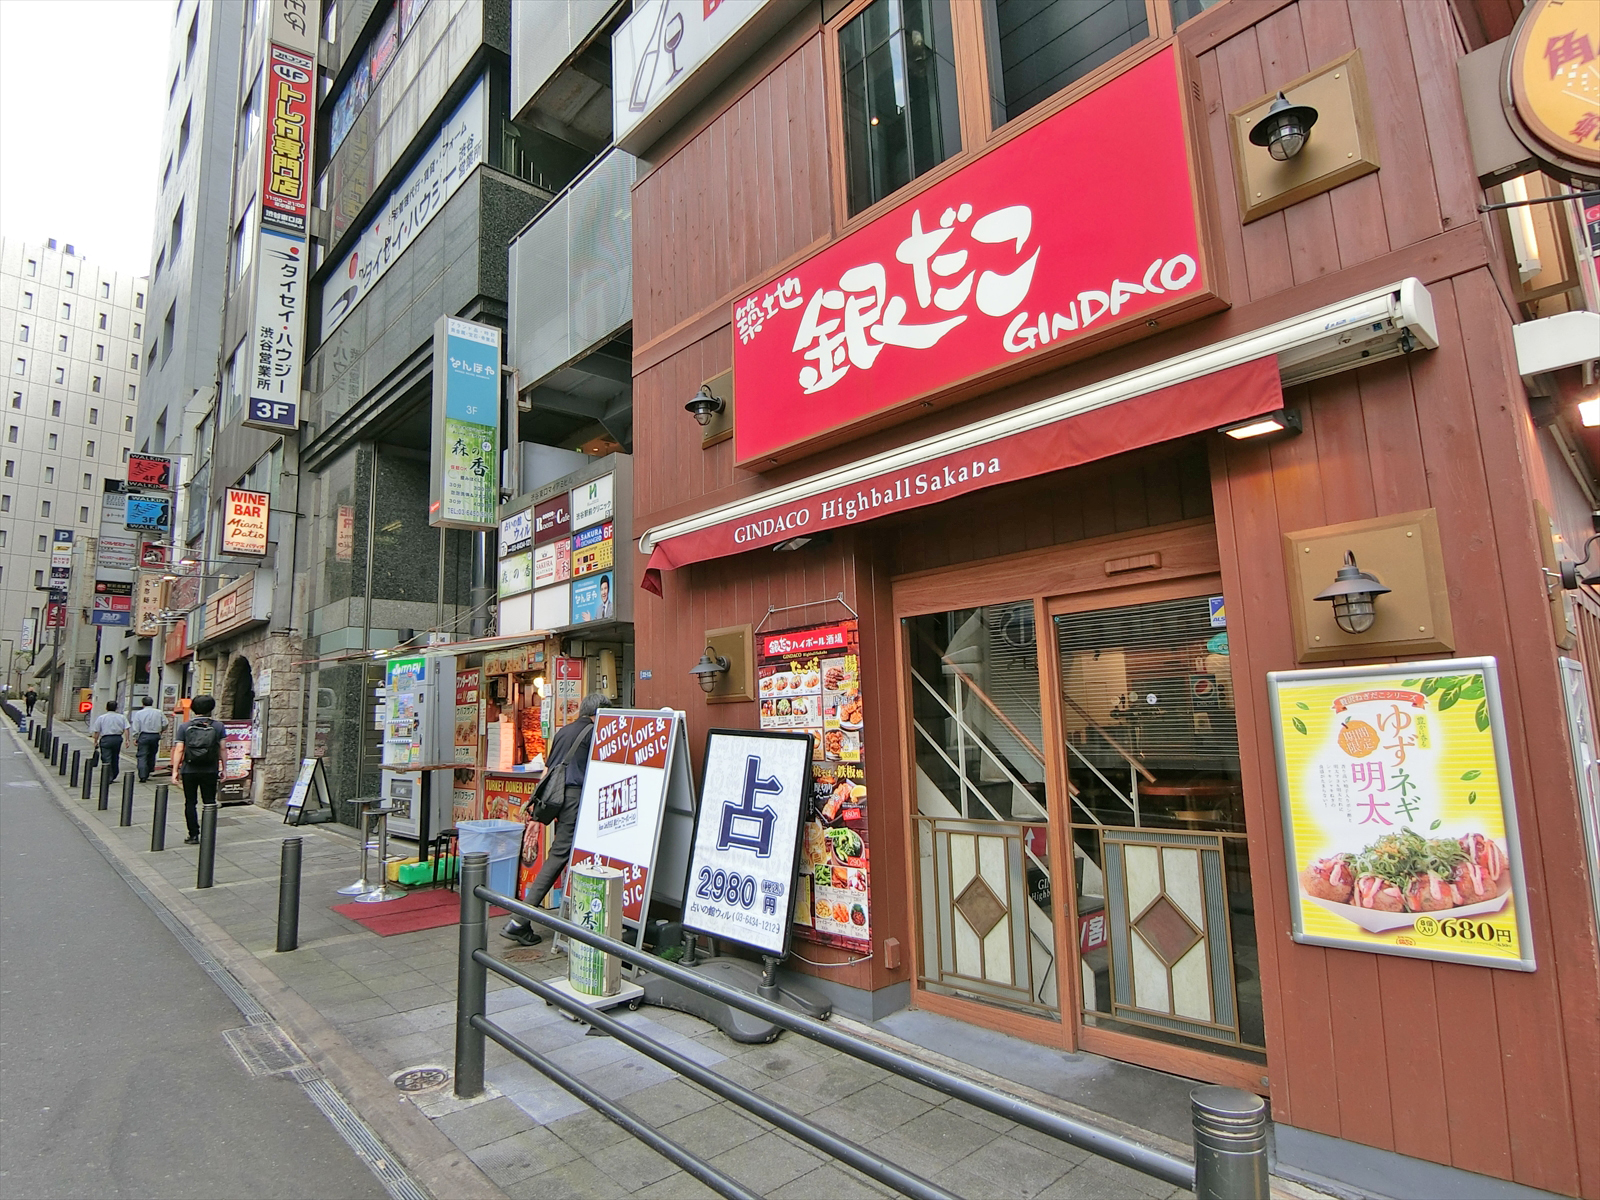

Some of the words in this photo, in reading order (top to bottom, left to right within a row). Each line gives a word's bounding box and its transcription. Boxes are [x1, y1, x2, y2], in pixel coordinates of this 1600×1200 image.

[270, 82, 305, 198] トレカ専門店
[735, 275, 804, 345] 築地
[792, 203, 1040, 395] 銀だこ
[1003, 253, 1197, 353] GINDACO
[274, 263, 298, 394] タイセイ・ハウジー
[256, 325, 275, 392] 渋谷営業所
[256, 401, 290, 420] 3F
[466, 406, 478, 415] 3F
[142, 474, 156, 482] 4F
[231, 491, 266, 507] WINE
[233, 504, 261, 518] BAR
[734, 508, 810, 543] GINDACO
[820, 478, 911, 520] Highball
[915, 456, 1001, 496] Sakaba
[142, 516, 155, 524] 3F
[227, 518, 264, 530] Miami
[603, 525, 614, 539] 6F
[59, 532, 69, 541] P
[231, 528, 265, 539] Patio
[595, 721, 618, 744] LOVE
[618, 715, 628, 729] &
[629, 723, 654, 748] LOVE
[656, 717, 666, 732] &
[598, 738, 629, 762] MUSIC
[634, 735, 668, 765] MUSIC
[486, 779, 504, 792] TURKEY
[1351, 761, 1394, 826] 明太
[716, 755, 783, 858] 占
[696, 866, 757, 910] 2980
[690, 902, 732, 920] 占いの館ウィル
[763, 895, 778, 915] 円
